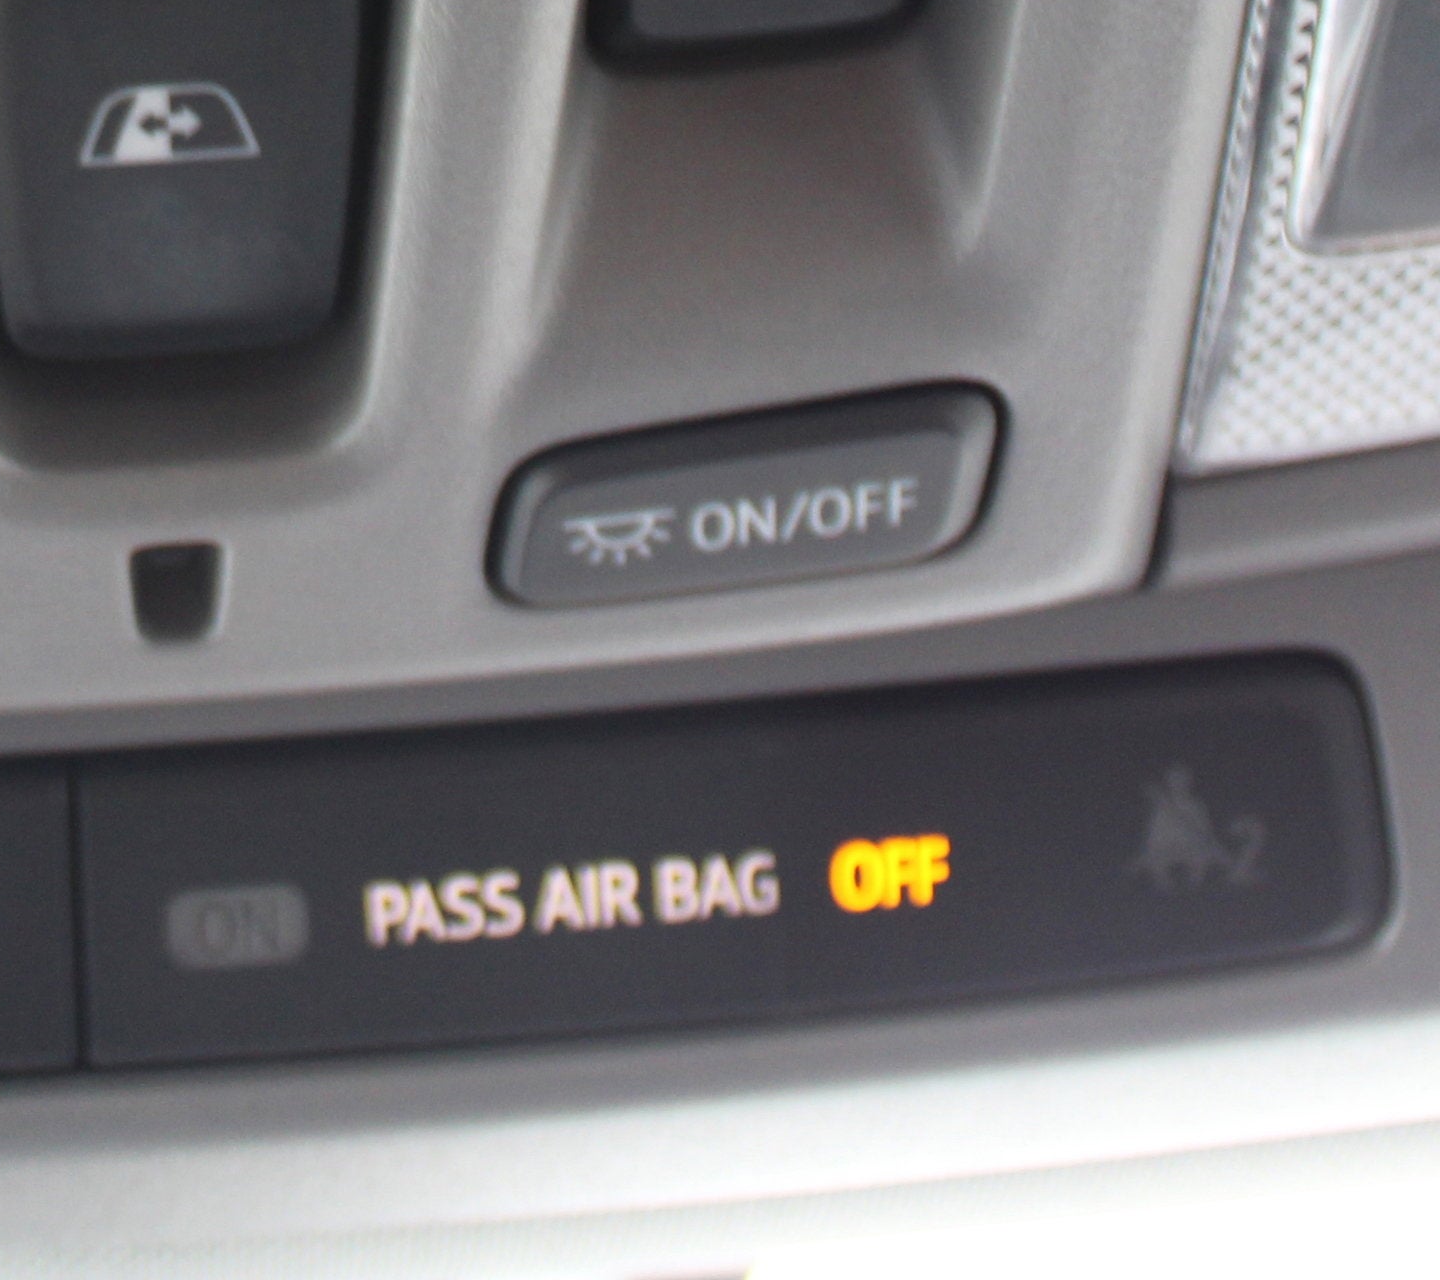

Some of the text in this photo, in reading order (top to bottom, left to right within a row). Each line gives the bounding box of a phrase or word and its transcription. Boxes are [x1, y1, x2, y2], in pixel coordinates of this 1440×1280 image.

[690, 476, 920, 553] ON/OFF
[363, 833, 951, 948] PASS AIR BAG OFF
